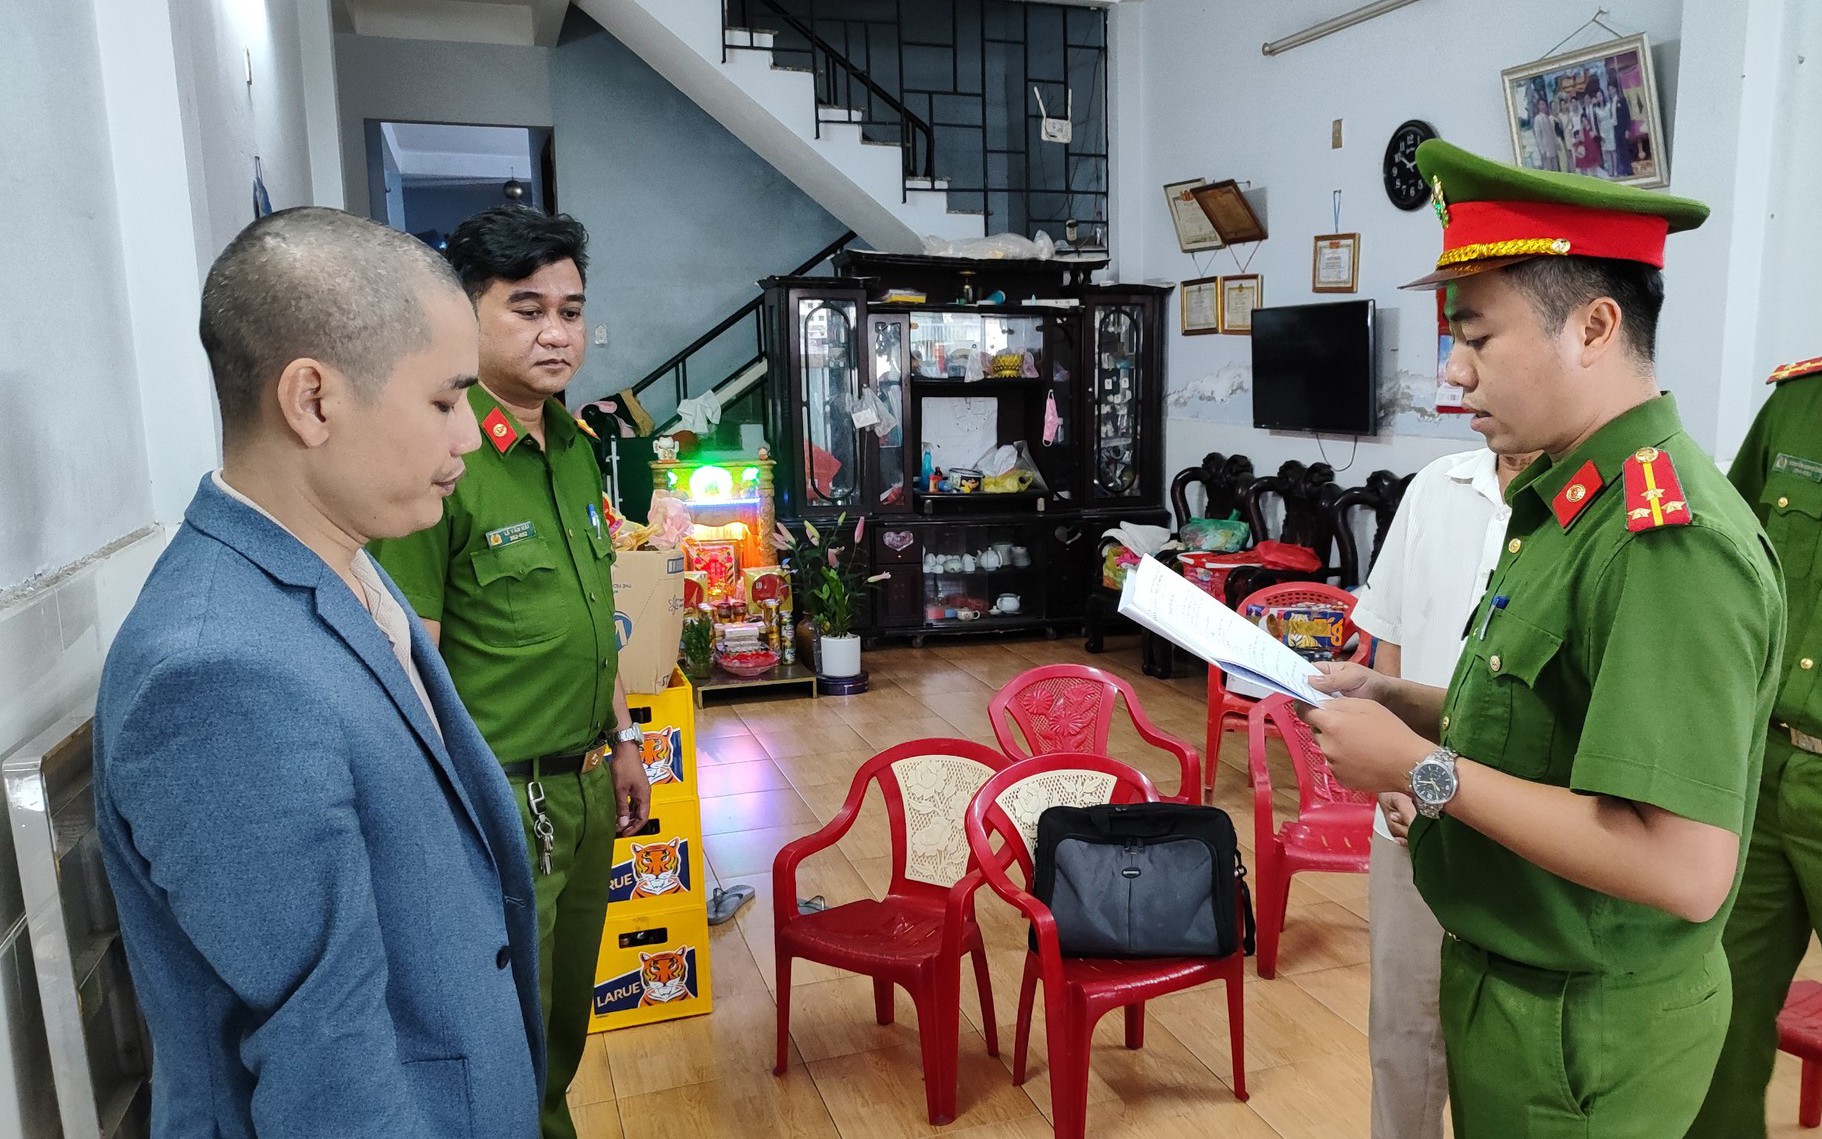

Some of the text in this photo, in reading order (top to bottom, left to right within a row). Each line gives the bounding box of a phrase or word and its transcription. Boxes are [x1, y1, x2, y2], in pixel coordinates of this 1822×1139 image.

[1392, 166, 1398, 177] 9
[1402, 185, 1407, 195] 7
[1409, 186, 1415, 197] 6
[609, 873, 633, 890] RUE
[596, 981, 641, 1008] LARUE
